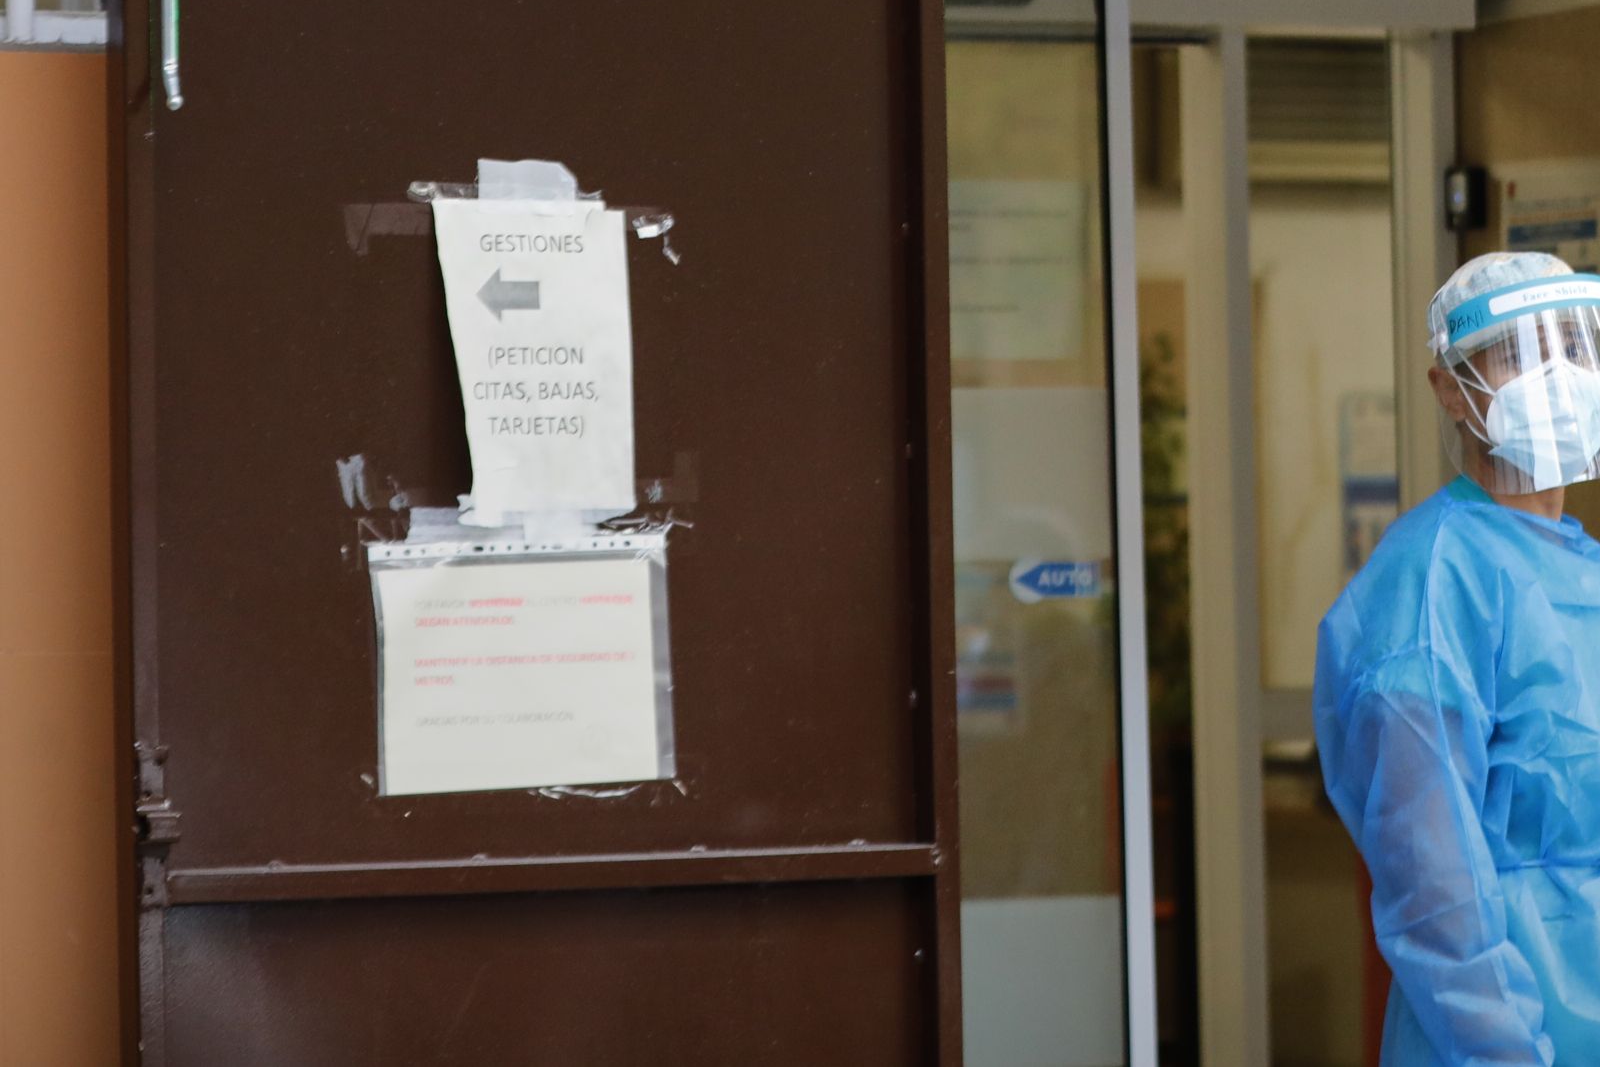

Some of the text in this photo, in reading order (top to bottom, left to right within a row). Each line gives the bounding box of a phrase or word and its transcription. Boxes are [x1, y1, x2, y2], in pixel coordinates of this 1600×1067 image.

[480, 235, 584, 254] GESTIONES
[1522, 285, 1588, 303] Face Shield
[1450, 310, 1484, 334] DANI
[488, 347, 584, 369] (PETICION
[473, 382, 600, 403] CITAS, BAJAS,
[488, 416, 584, 438] TARJETAS)
[1038, 569, 1093, 586] AUTO
